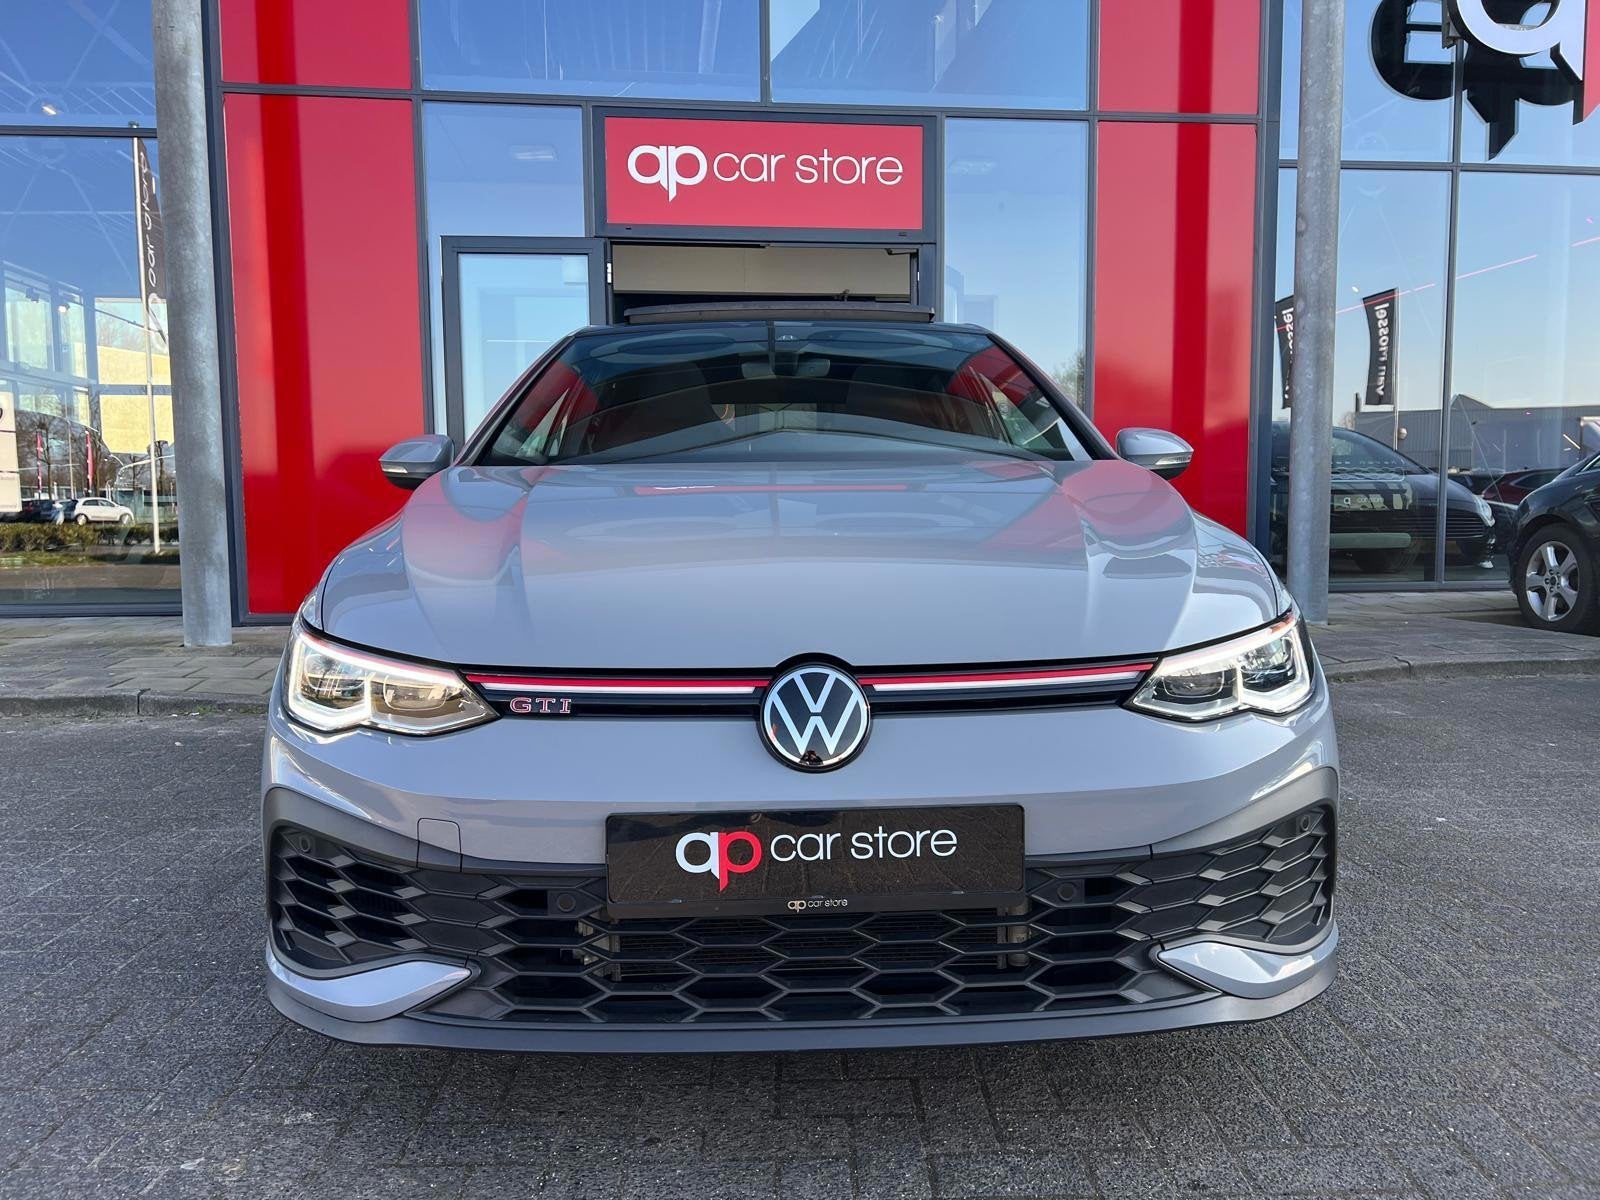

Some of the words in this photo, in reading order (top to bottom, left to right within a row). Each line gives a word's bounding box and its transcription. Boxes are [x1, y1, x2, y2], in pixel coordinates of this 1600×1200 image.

[627, 145, 708, 202] ap
[713, 152, 785, 182] car
[795, 148, 903, 186] store
[509, 696, 572, 714] GTI
[675, 831, 763, 892] ap
[770, 832, 841, 862] car
[850, 825, 958, 860] store
[787, 900, 807, 913] ap
[807, 900, 823, 908] car
[824, 898, 849, 907] store
